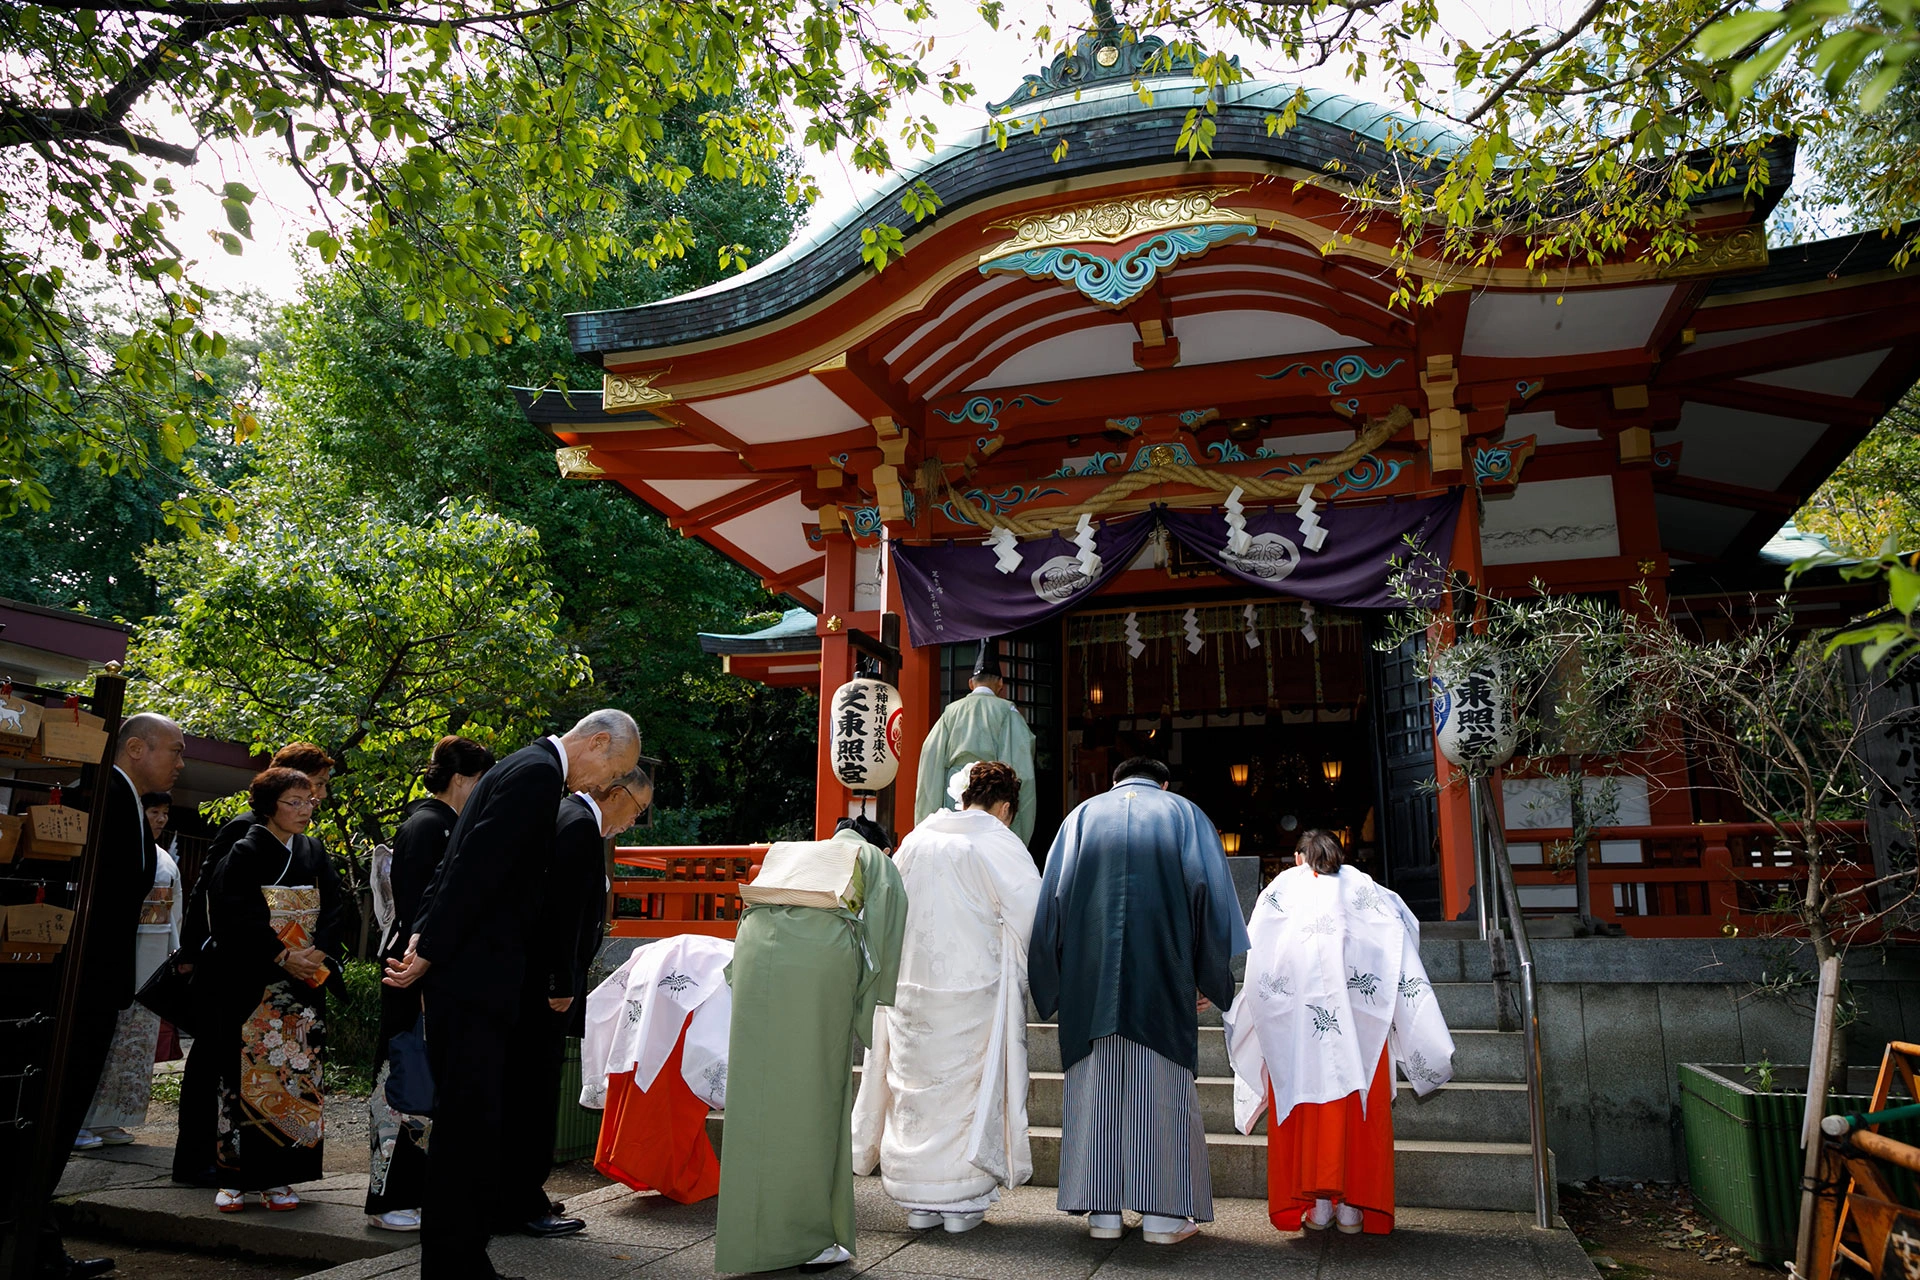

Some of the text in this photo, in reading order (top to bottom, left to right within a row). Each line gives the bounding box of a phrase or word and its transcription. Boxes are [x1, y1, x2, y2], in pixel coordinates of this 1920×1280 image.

[837, 683, 870, 784] 芝東照宮
[872, 683, 889, 764] 祭神徳川家康公
[1455, 667, 1498, 760] 東照宮
